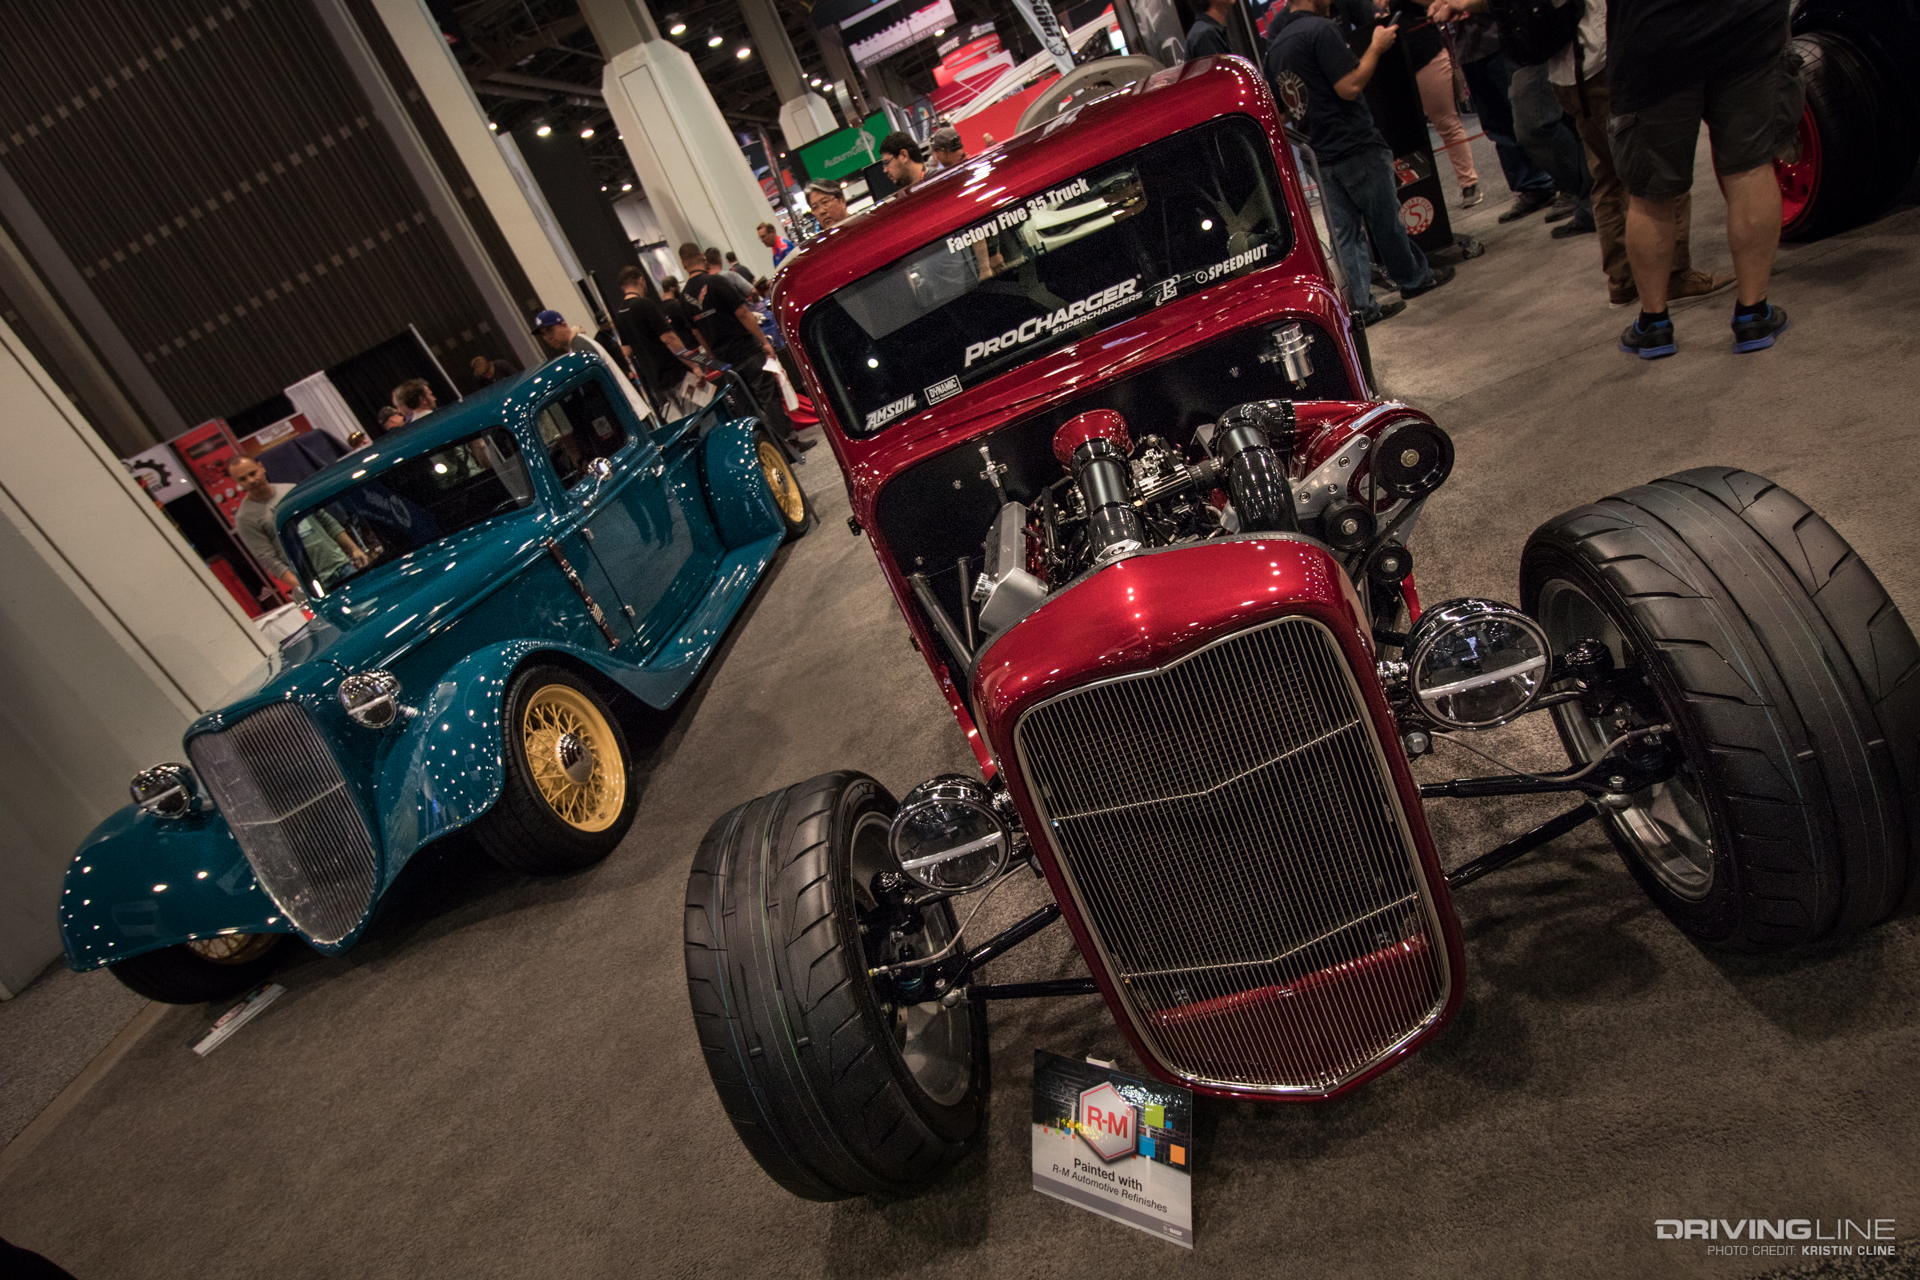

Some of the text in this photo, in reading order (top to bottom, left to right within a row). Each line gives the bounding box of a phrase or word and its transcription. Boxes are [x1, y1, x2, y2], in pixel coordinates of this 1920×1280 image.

[946, 219, 999, 254] Factory
[996, 207, 1028, 231] Five
[1026, 195, 1048, 213] 35
[1046, 178, 1090, 206] Truck
[1208, 243, 1268, 280] SPEEDHUT
[1052, 291, 1143, 335] SUPERCHARGERS
[928, 378, 958, 399] DYNAMIC
[864, 393, 917, 431] AMSOIL
[1087, 1104, 1128, 1139] R-M
[1052, 1163, 1070, 1178] R-M
[1071, 1173, 1120, 1196] Automotive
[1121, 1188, 1168, 1213] Refinishes
[1074, 1157, 1143, 1192] Painted with
